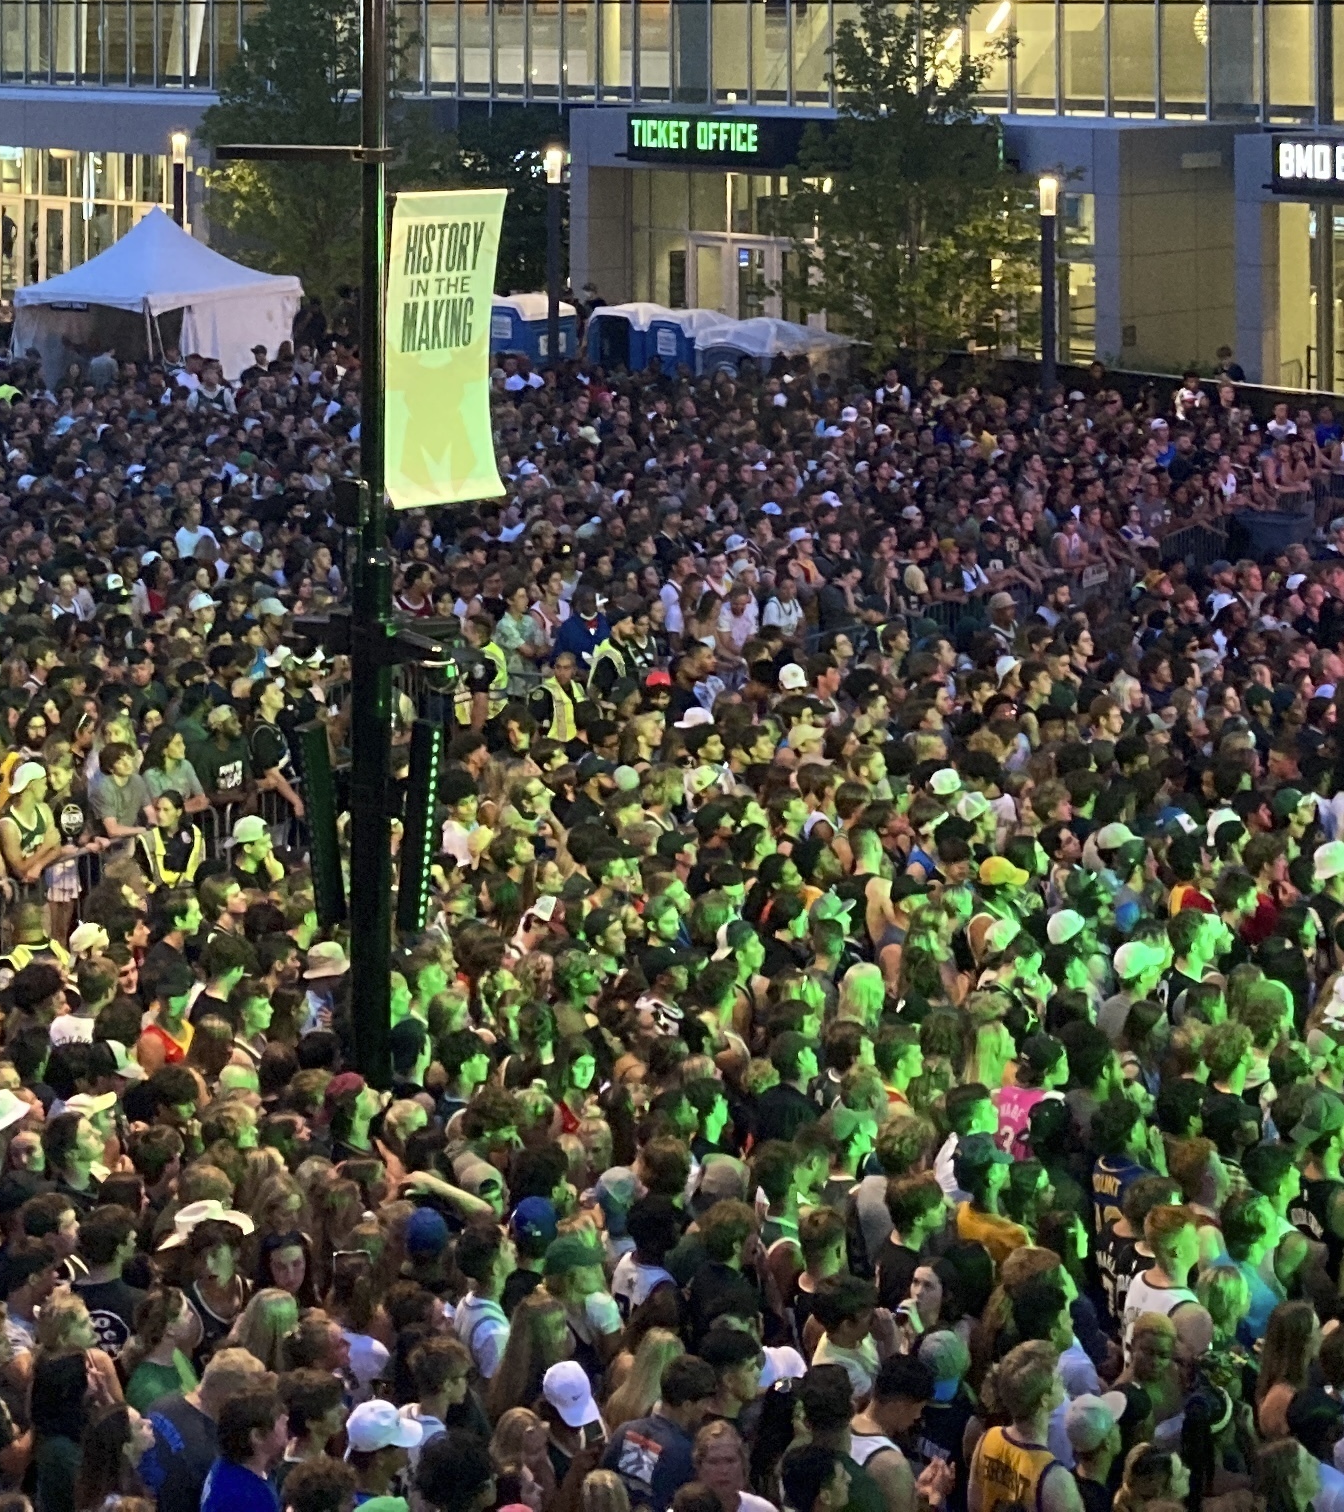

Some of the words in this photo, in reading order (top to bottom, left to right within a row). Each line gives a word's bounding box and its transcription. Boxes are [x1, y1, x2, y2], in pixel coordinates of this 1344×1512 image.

[631, 120, 690, 149] TICKET
[697, 121, 757, 152] OFFICE
[1279, 143, 1332, 179] BMO
[404, 221, 485, 276] HISTORY
[409, 279, 428, 297] IN
[434, 276, 472, 294] THE
[401, 297, 474, 353] MAKING
